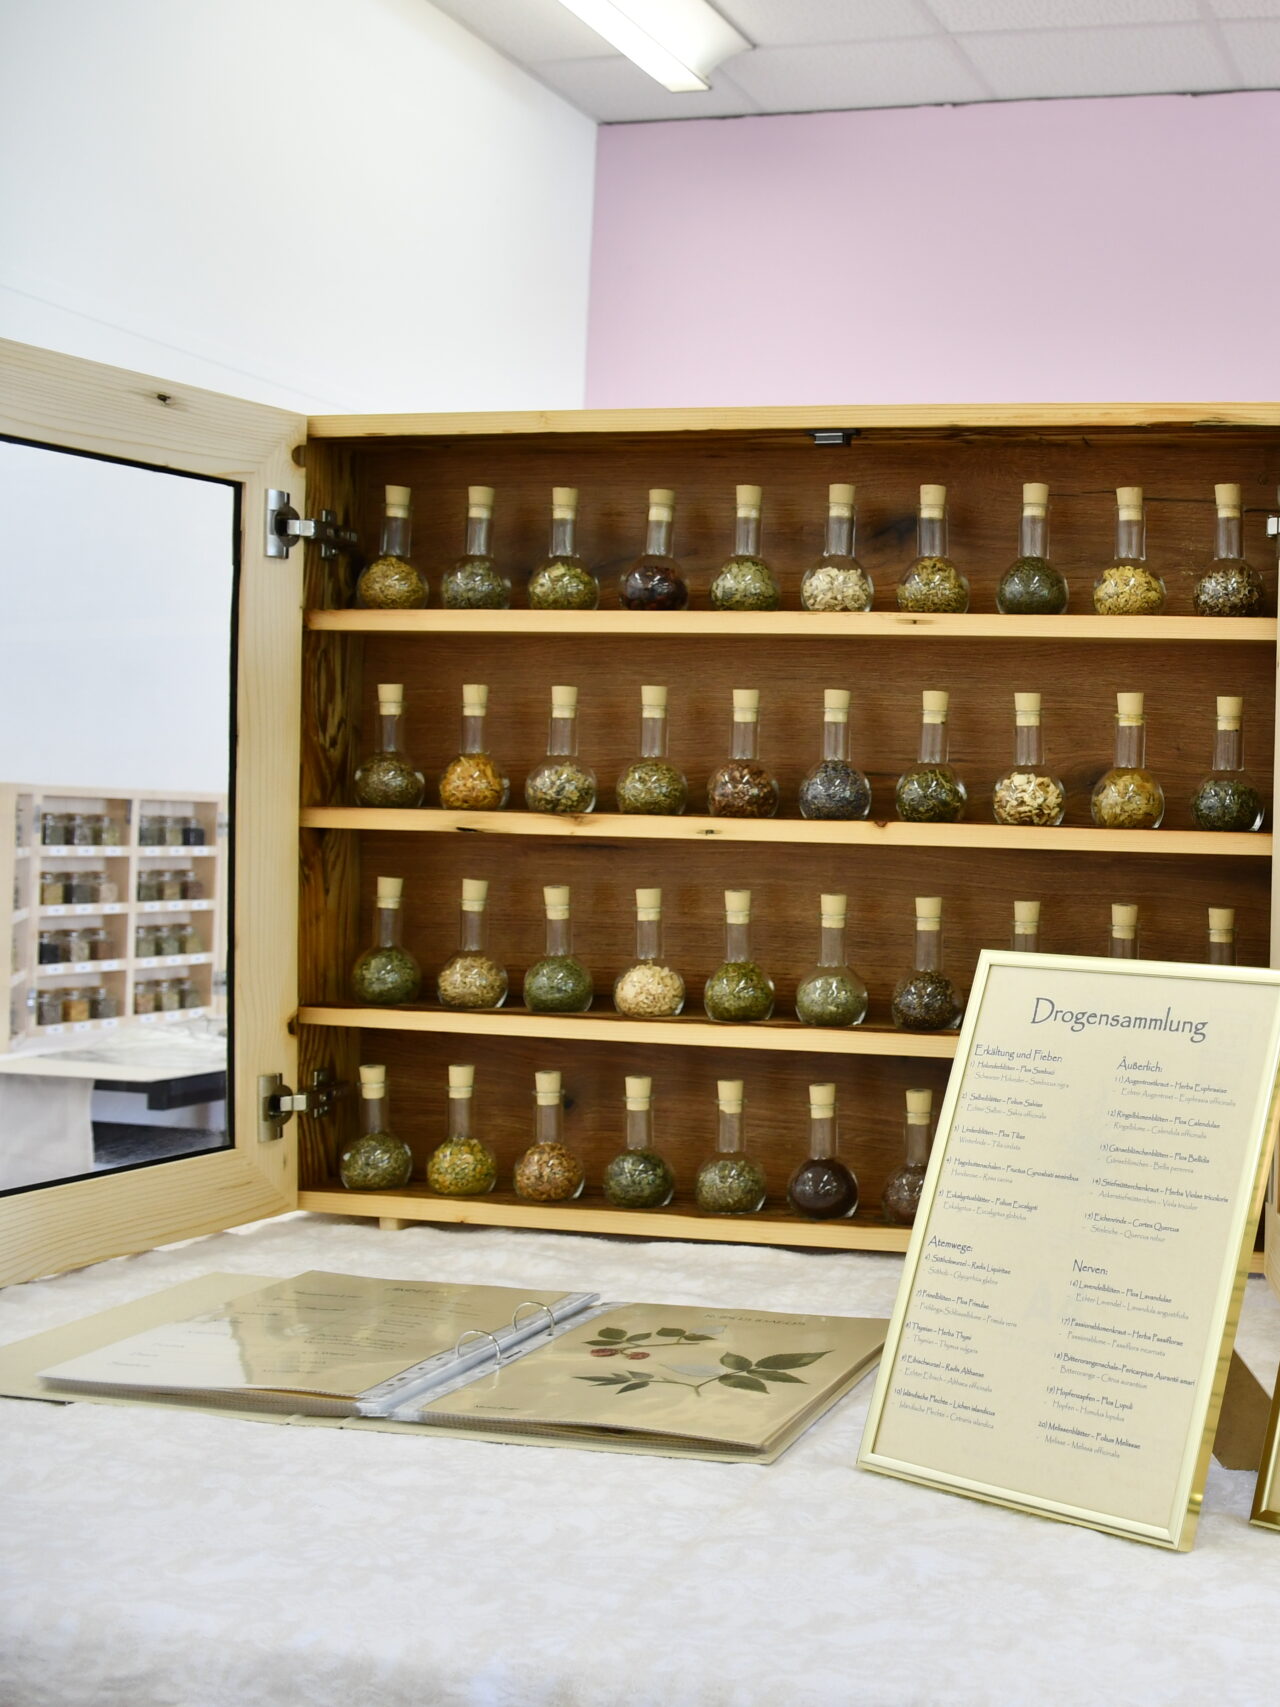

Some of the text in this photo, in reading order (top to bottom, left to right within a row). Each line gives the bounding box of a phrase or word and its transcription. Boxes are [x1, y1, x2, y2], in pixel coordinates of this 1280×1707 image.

[1030, 997, 1208, 1043] Drogensammlung
[974, 1043, 1015, 1061] Erkältung
[1016, 1048, 1033, 1060] und
[1116, 1056, 1163, 1072] Äußerlich:
[1174, 1081, 1193, 1090] Herba
[1174, 1116, 1187, 1125] Flos
[1174, 1152, 1187, 1161] Flos
[1164, 1187, 1184, 1197] Herba
[927, 1235, 973, 1255] Atemwege:
[1072, 1259, 1108, 1276] Nerven:
[1125, 1288, 1139, 1297] Flos
[937, 1327, 954, 1337] Herba
[1132, 1330, 1151, 1340] Herba
[1055, 1387, 1096, 1402] Hopfenzapfen
[1101, 1396, 1114, 1406] Flos
[1095, 1432, 1115, 1443] Folium
